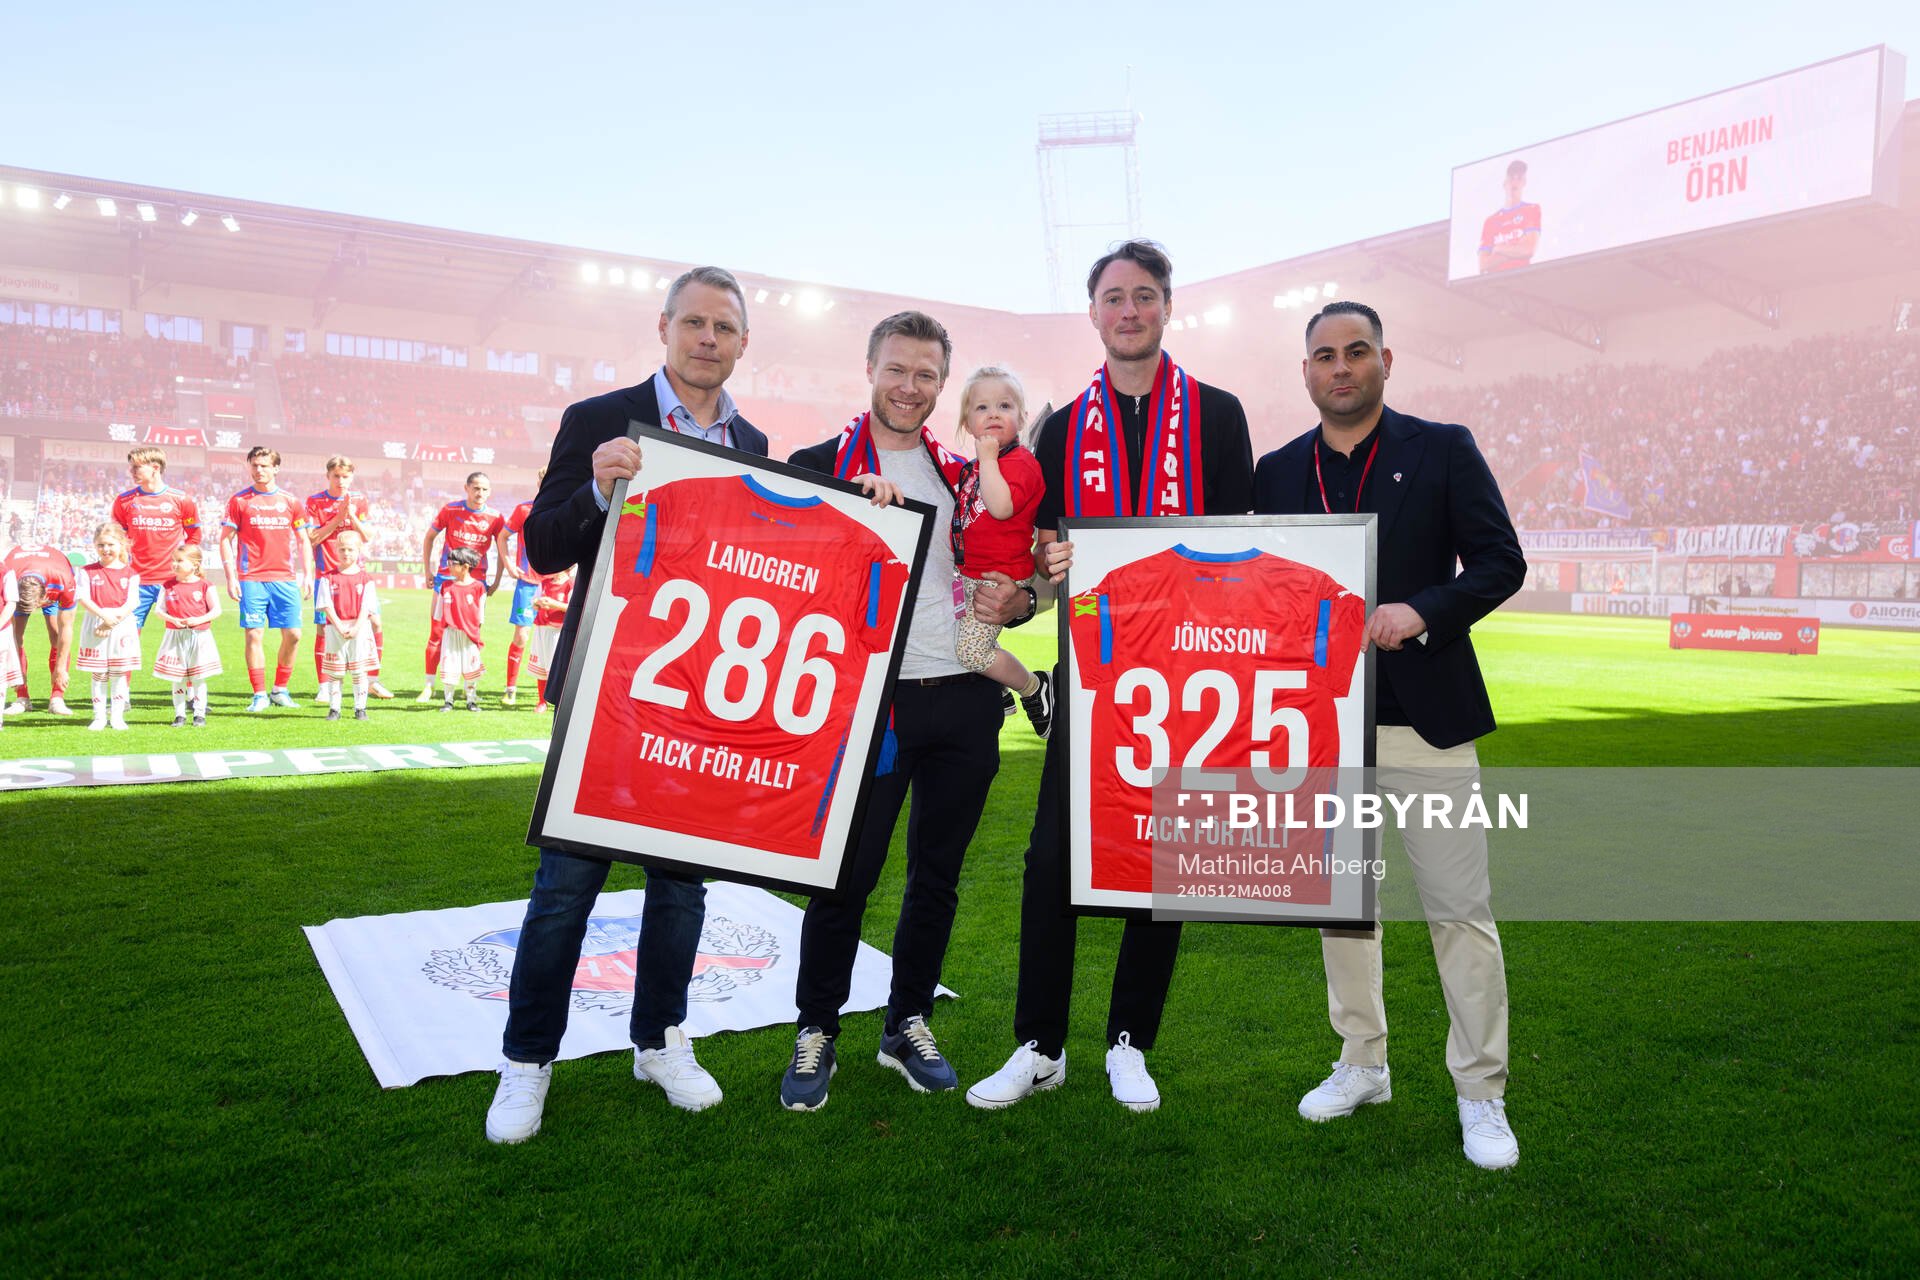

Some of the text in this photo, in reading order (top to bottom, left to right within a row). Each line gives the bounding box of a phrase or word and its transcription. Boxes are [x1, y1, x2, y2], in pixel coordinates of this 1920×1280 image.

[1667, 115, 1774, 166] BENJAMIN
[1685, 156, 1748, 203] ÖRN
[706, 541, 819, 594] LANDGREN
[628, 579, 846, 736] 286
[1170, 621, 1267, 655] JÖNSSON
[1113, 667, 1310, 792] 325
[639, 732, 800, 790] TACK FÖR ALLT
[1134, 814, 1187, 844] TACK
[1241, 821, 1290, 849] ALLT
